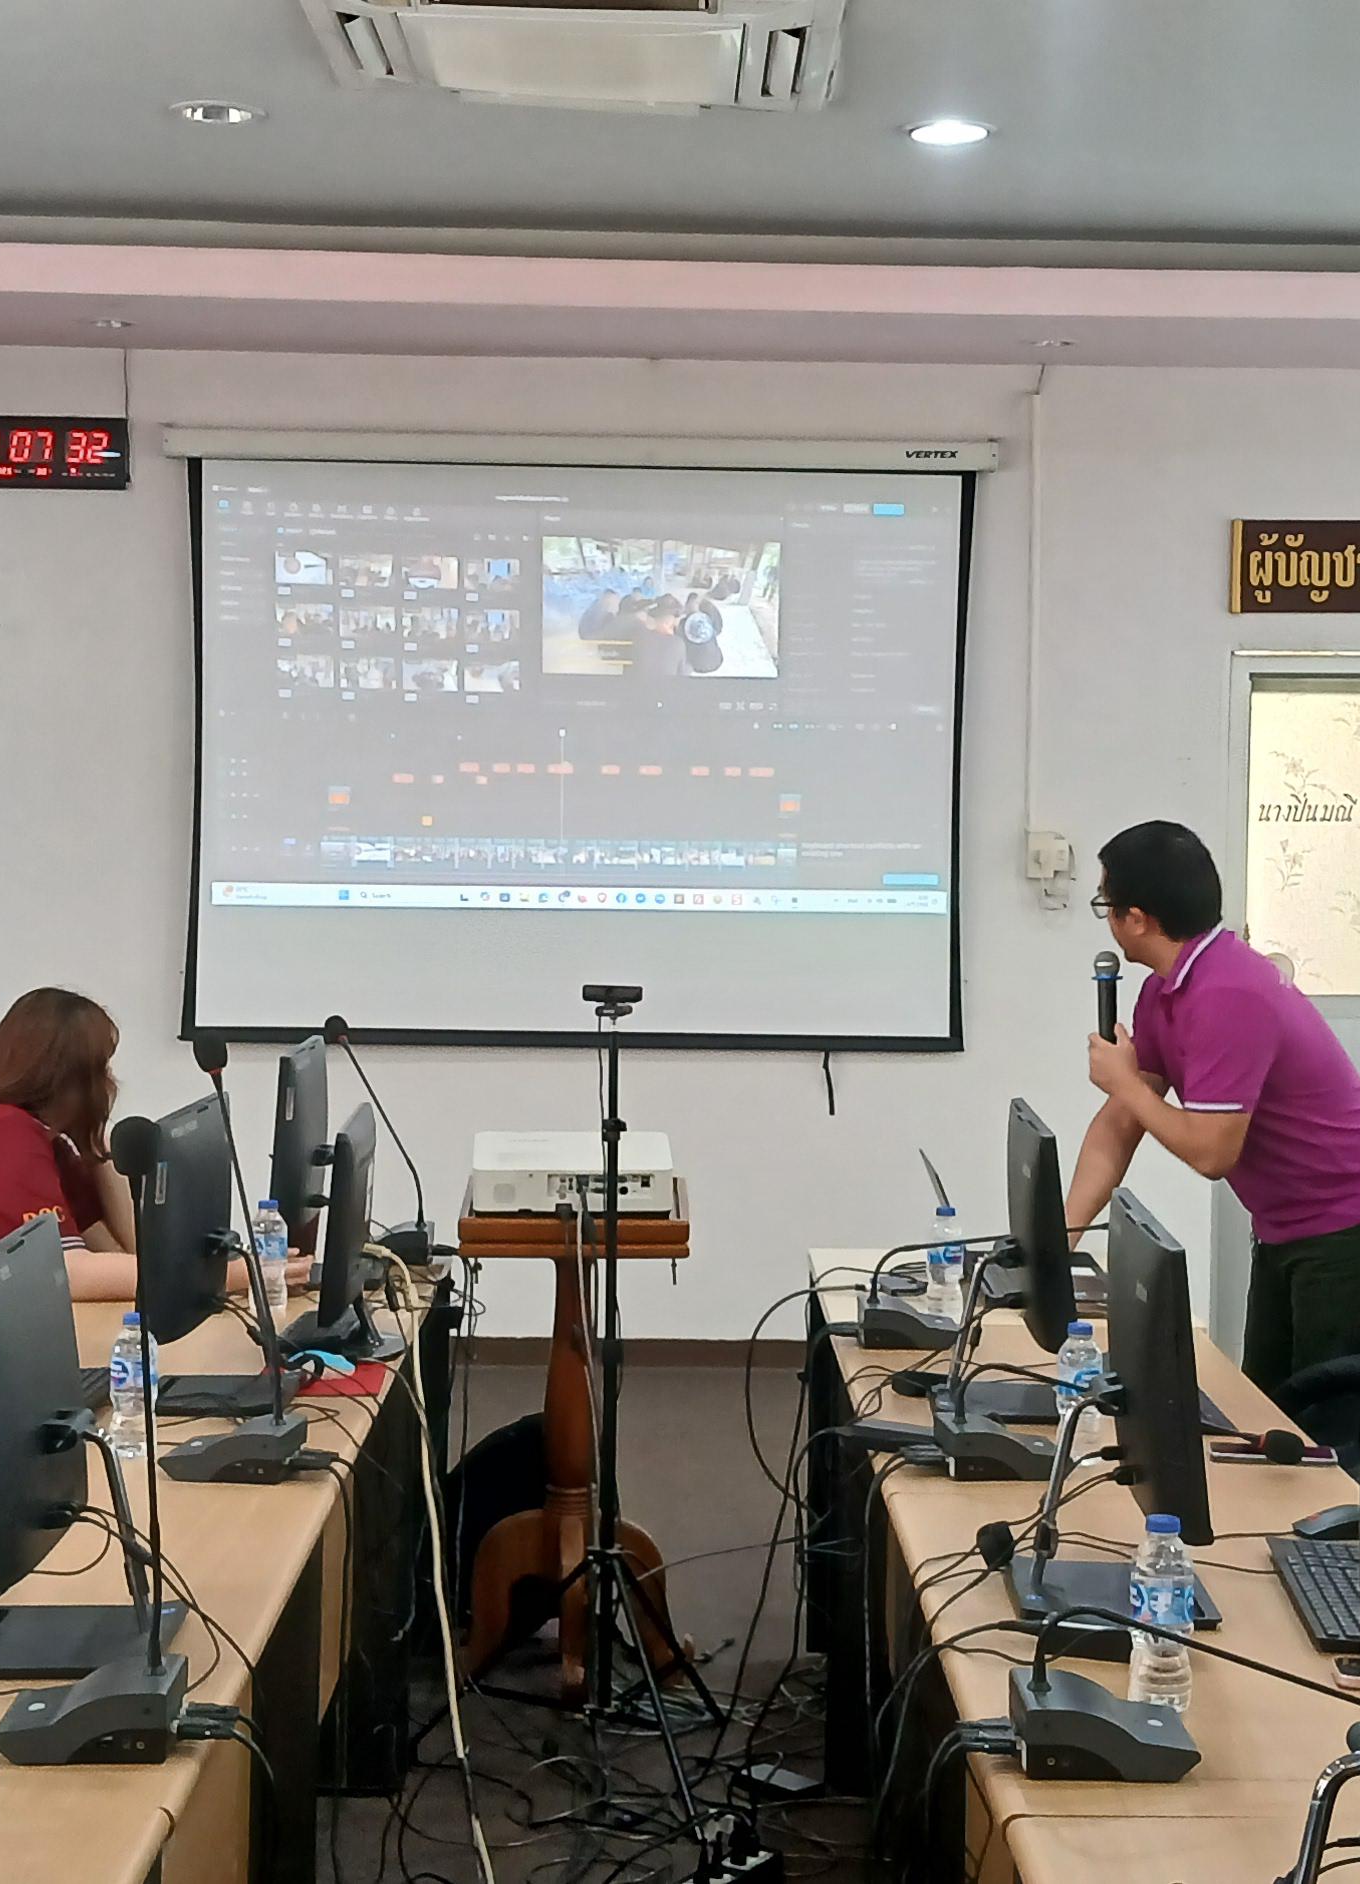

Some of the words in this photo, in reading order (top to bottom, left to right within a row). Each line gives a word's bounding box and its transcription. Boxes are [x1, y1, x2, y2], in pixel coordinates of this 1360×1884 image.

[9, 429, 53, 462] 07
[66, 430, 110, 464] 32
[905, 450, 959, 459] VERTEX
[1258, 792, 1358, 822] นางปิ่นมณี
